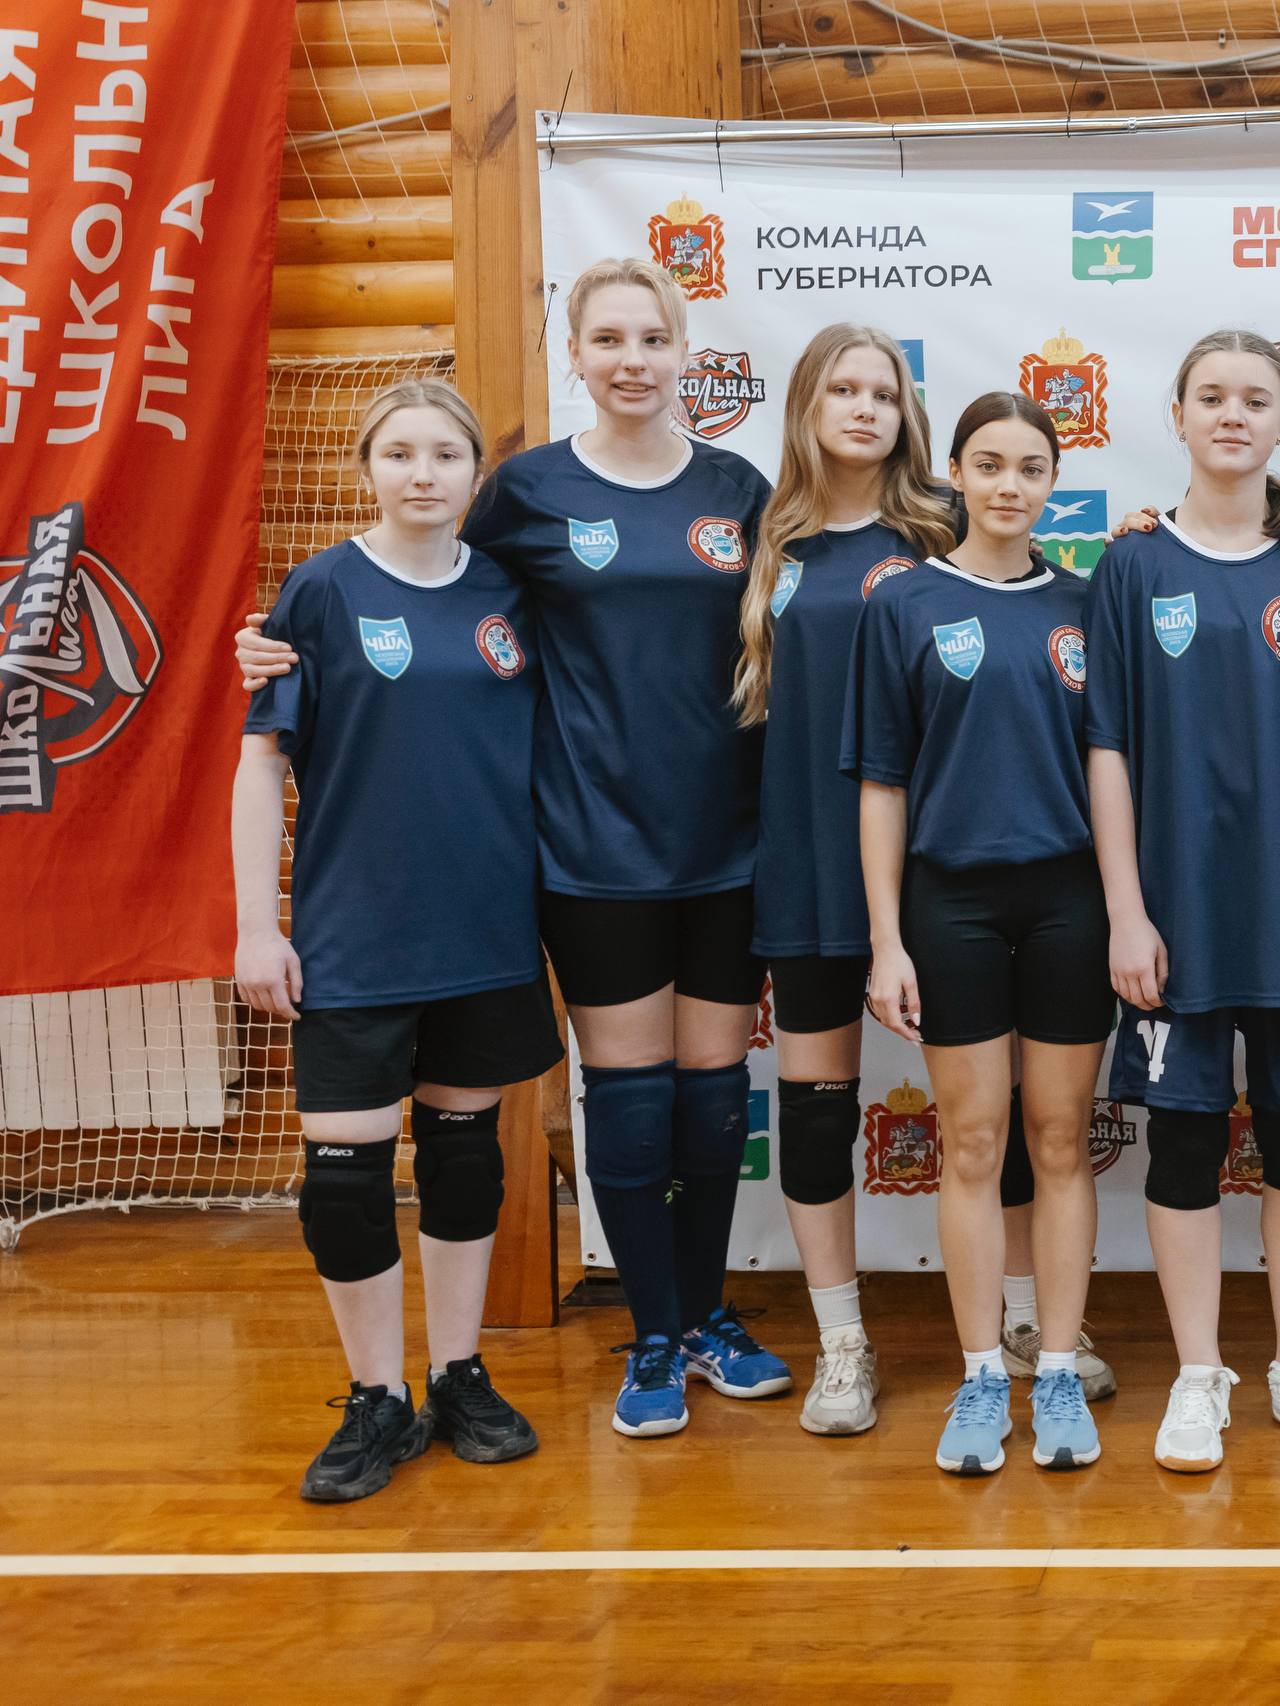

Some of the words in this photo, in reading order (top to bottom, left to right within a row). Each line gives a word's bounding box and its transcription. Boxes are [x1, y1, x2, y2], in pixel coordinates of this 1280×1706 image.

[756, 225, 927, 251] КОМАНДА
[757, 264, 993, 290] ГУБЕРНАТОРА
[136, 179, 215, 441] ЛИГА
[677, 377, 764, 399] КОЛЬНАЯ
[1062, 673, 1086, 691] ЧЕХОВ-
